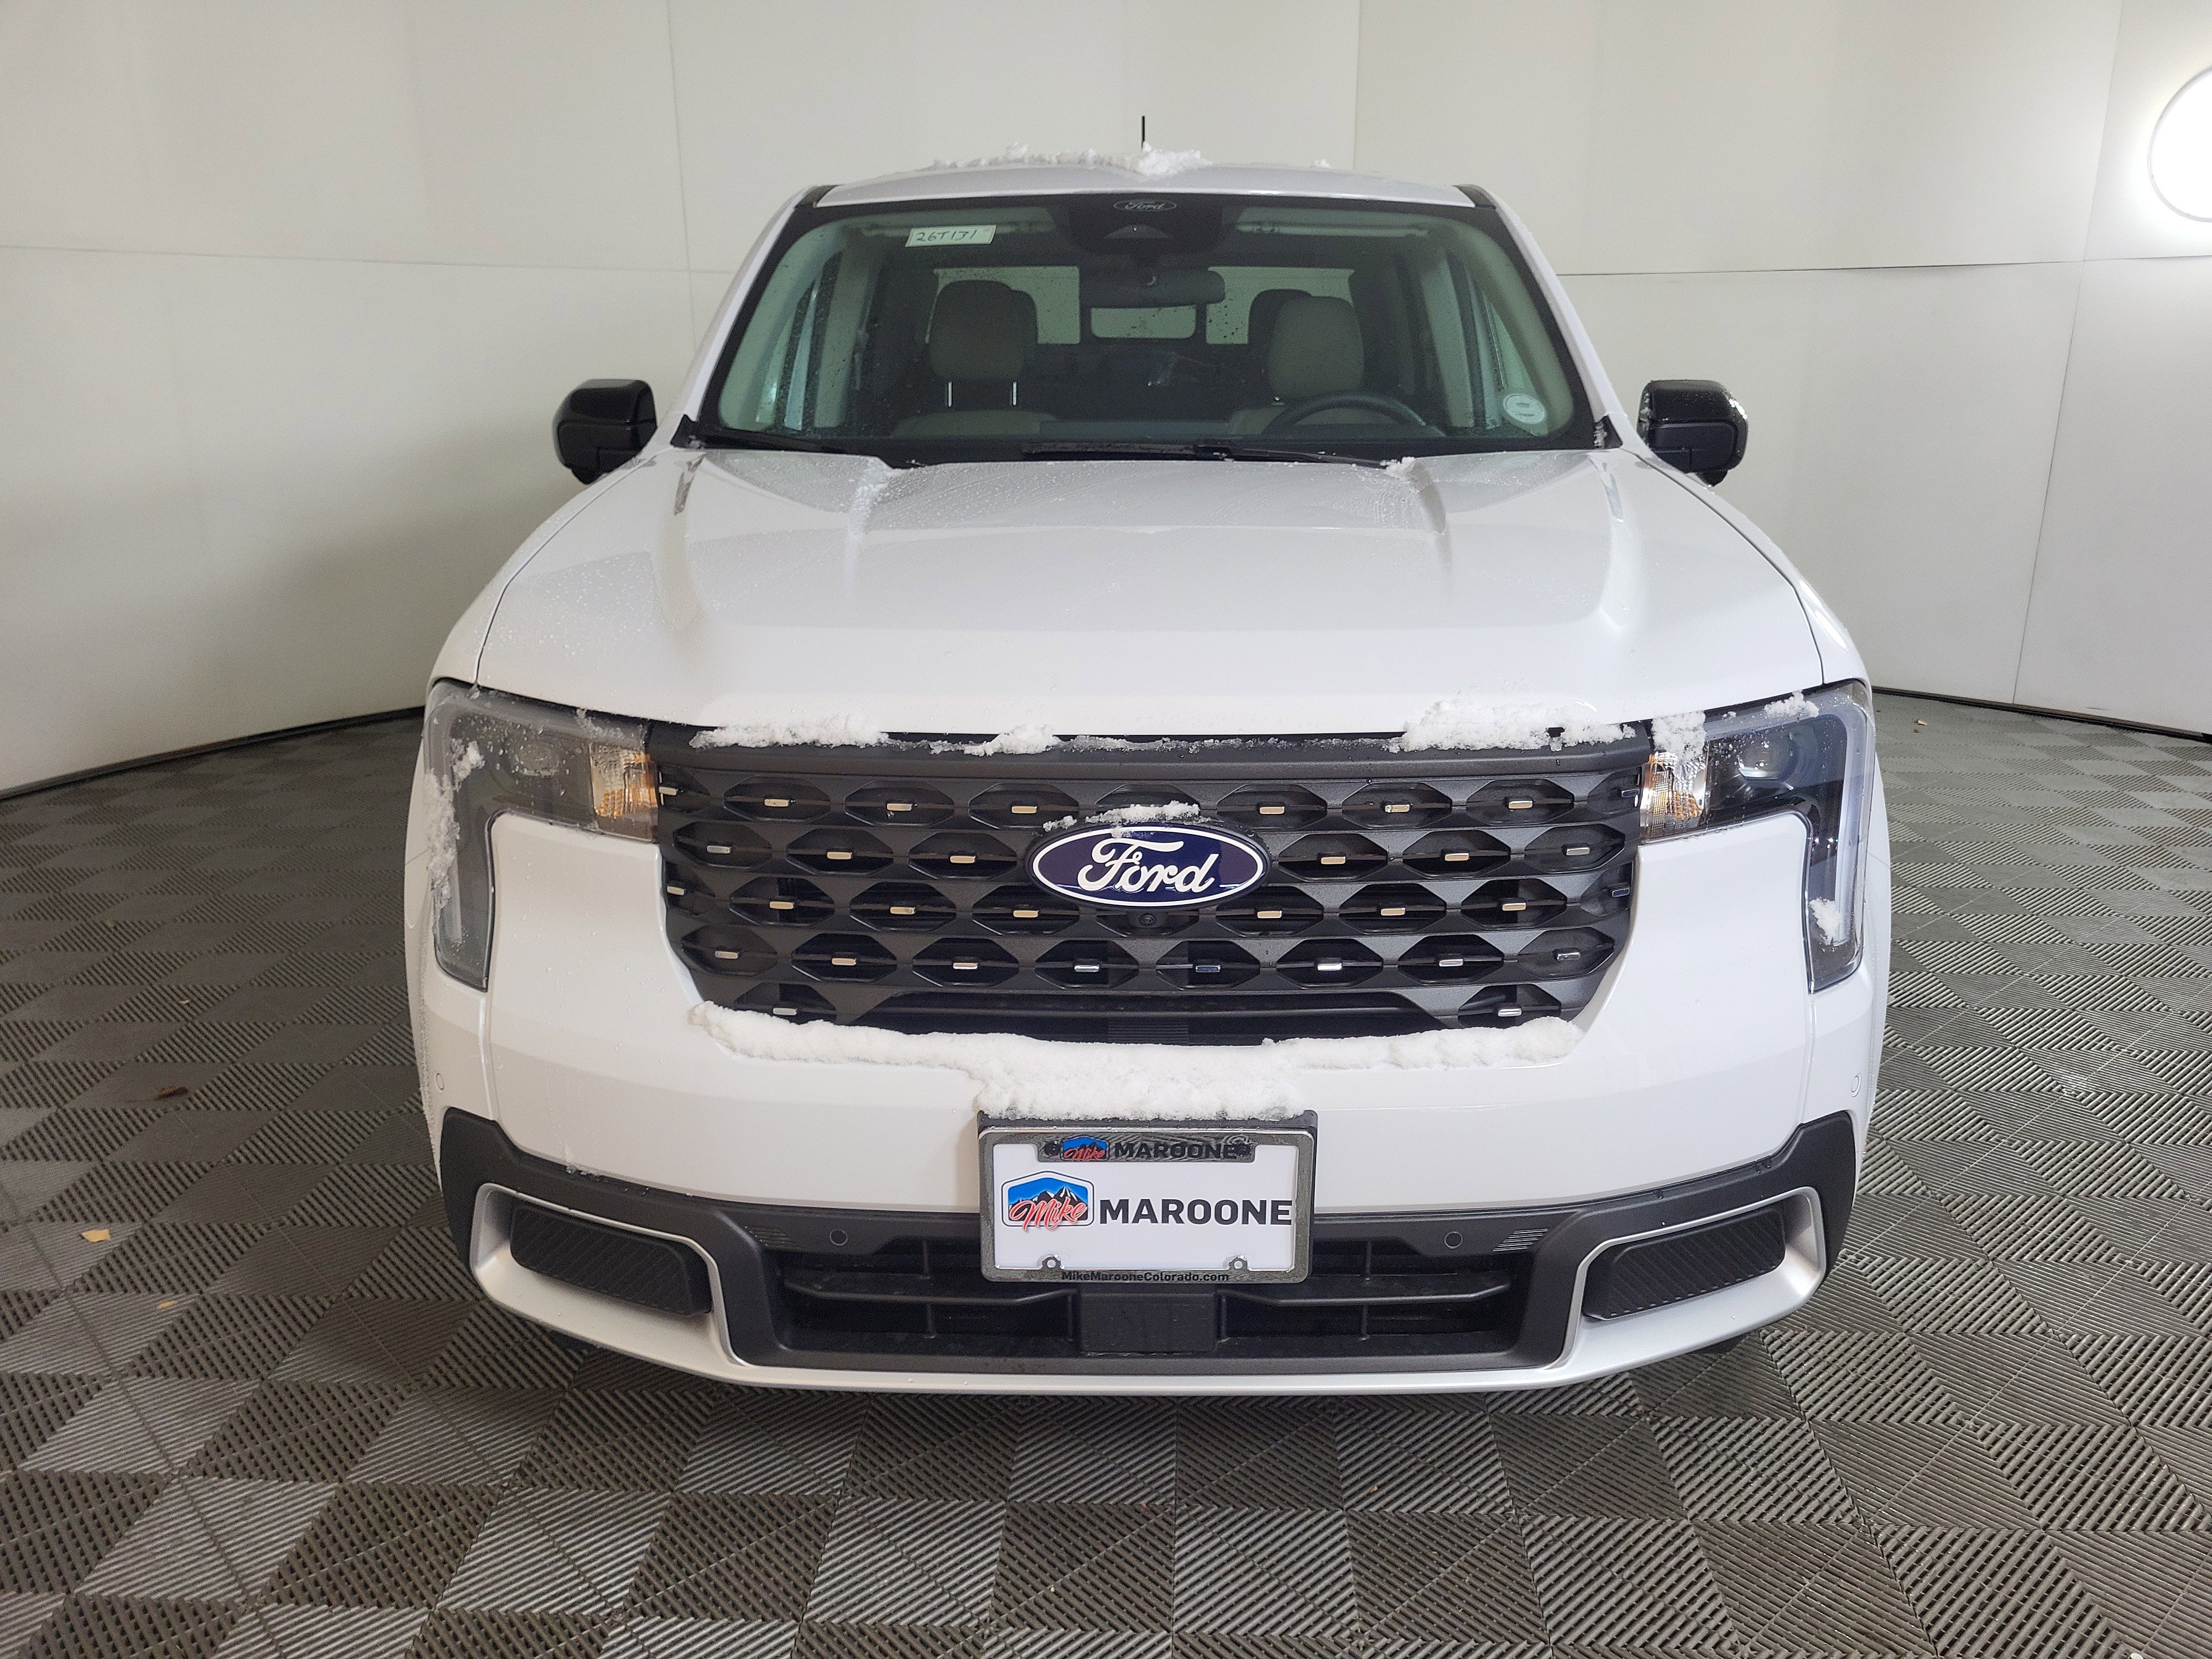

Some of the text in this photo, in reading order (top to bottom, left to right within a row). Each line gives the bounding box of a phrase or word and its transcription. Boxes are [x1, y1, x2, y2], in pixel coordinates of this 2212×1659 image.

[1125, 200, 1165, 209] Ford
[1077, 838, 1219, 893] Ford
[1063, 1143, 1237, 1161] Mike MAROONE
[1009, 1196, 1292, 1232] Mike MAROONE
[1061, 1272, 1230, 1282] MikeMarooneColorado.com
